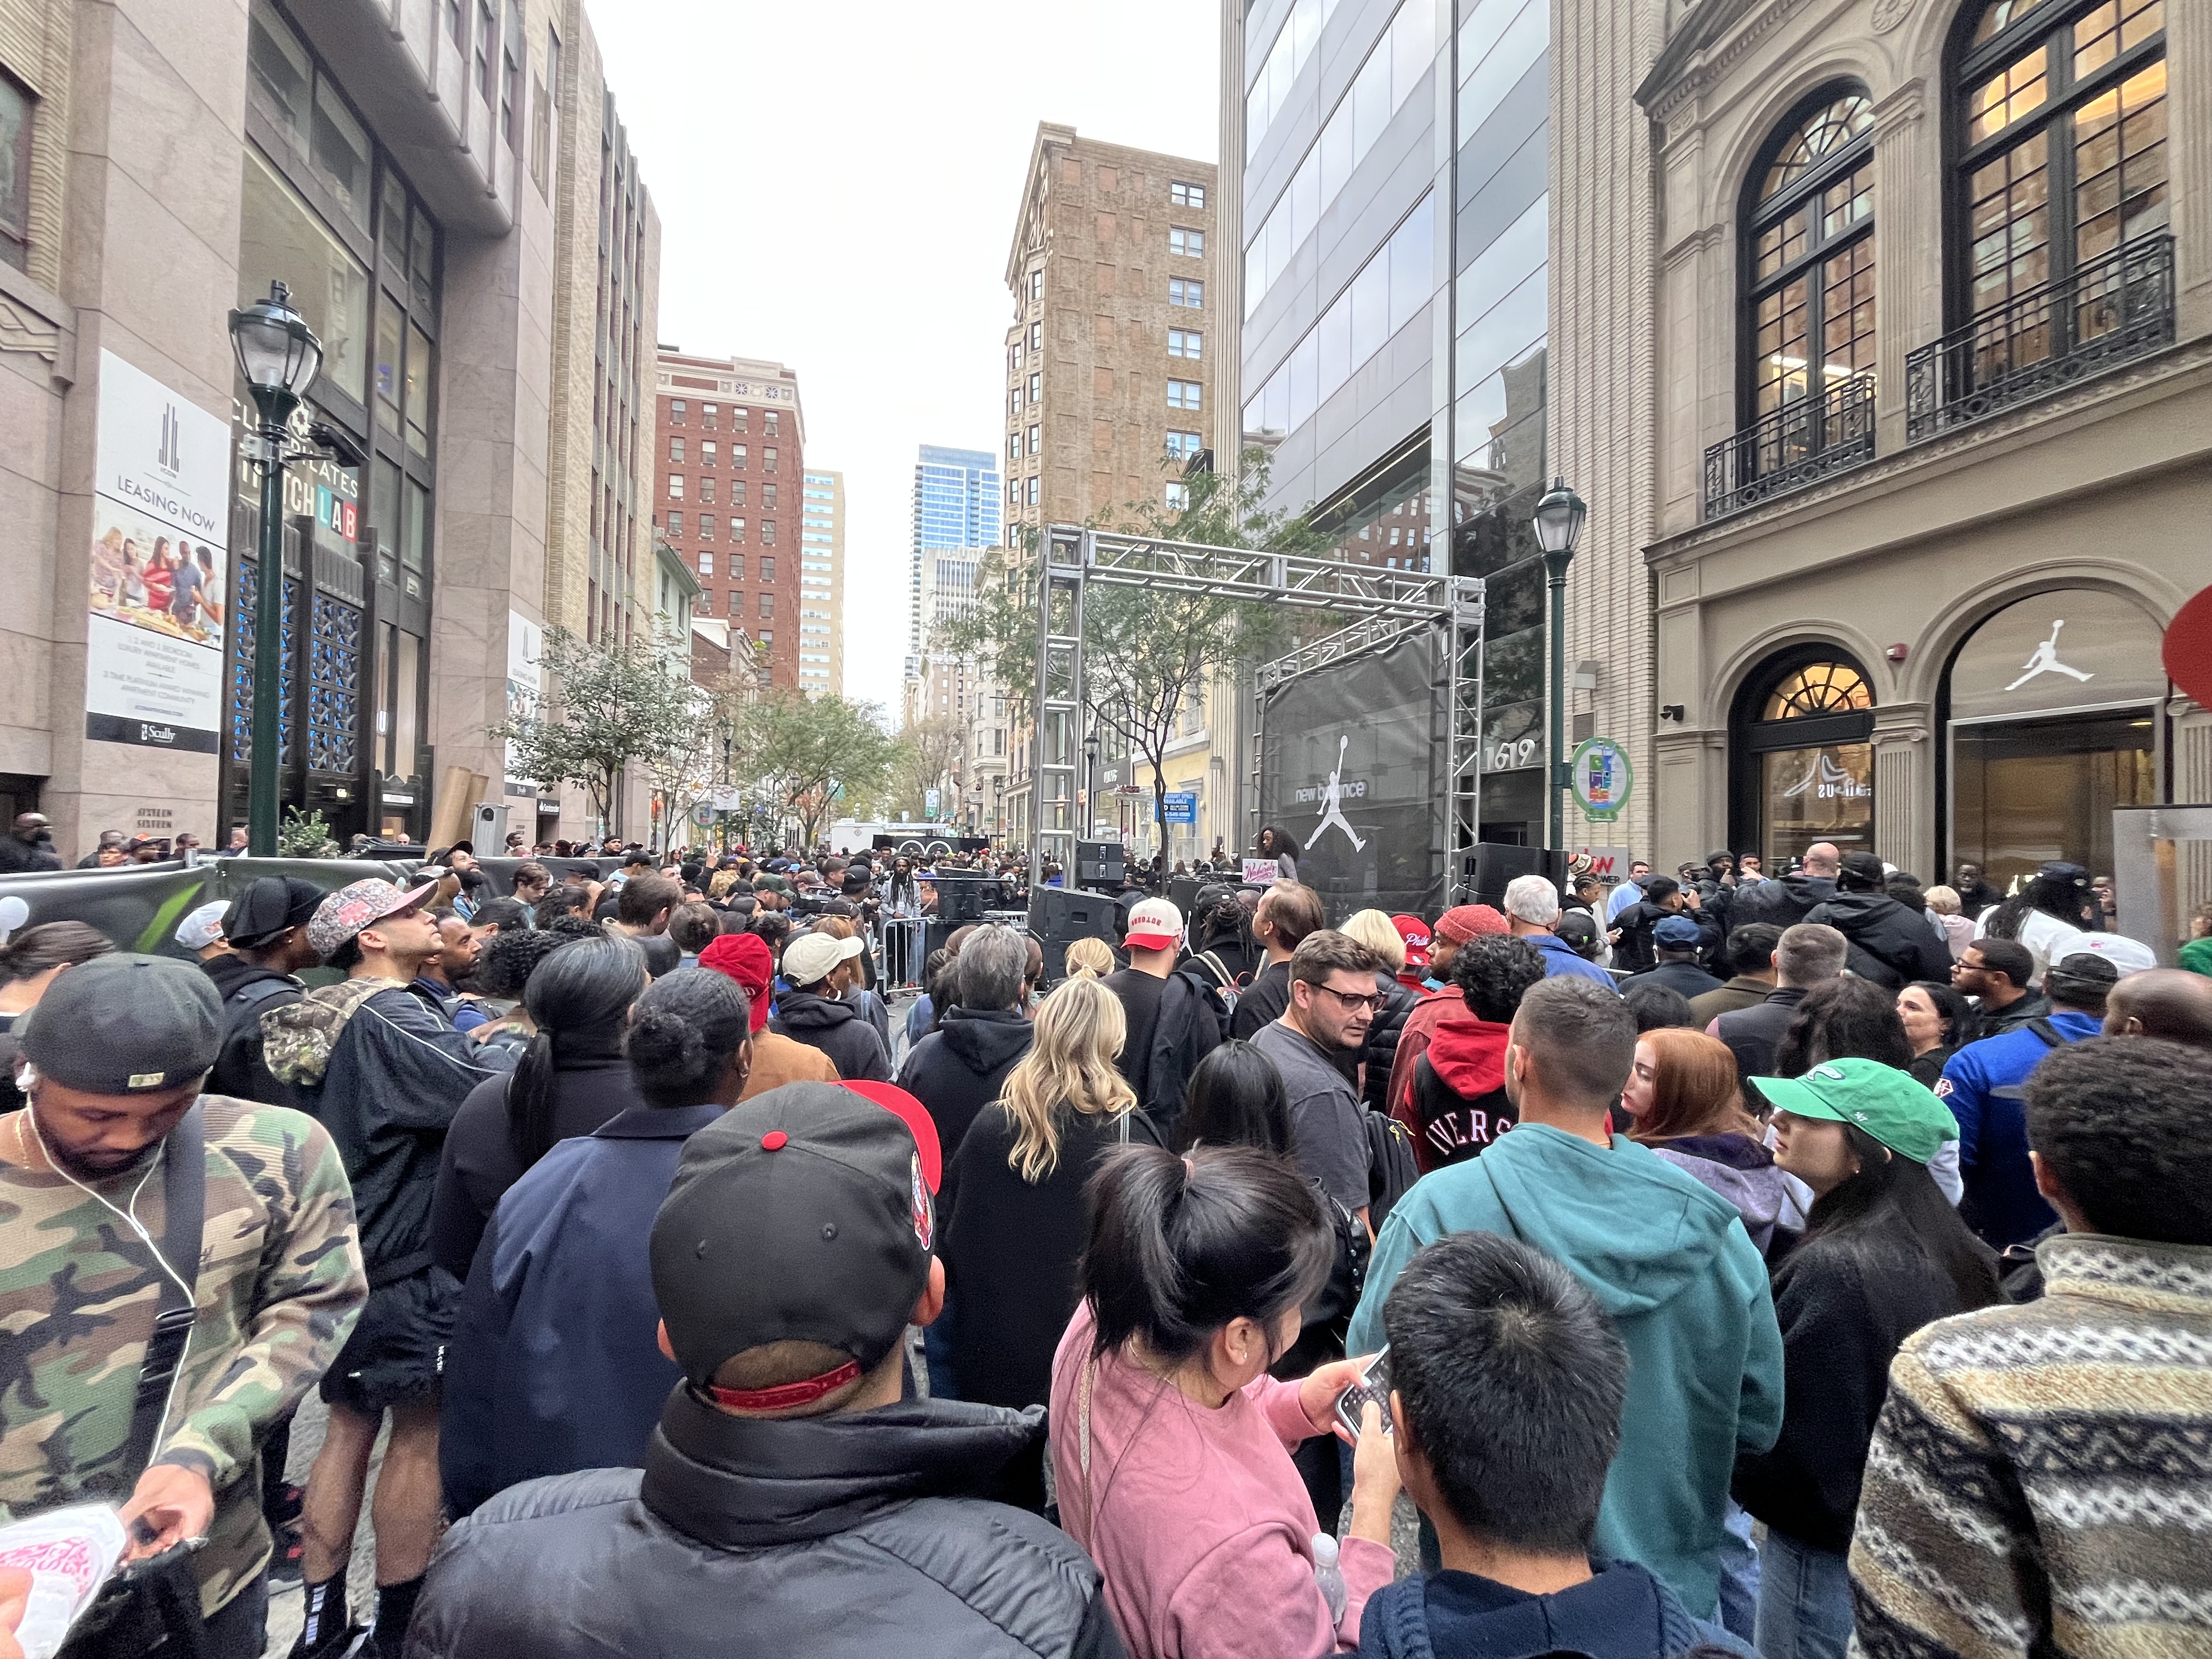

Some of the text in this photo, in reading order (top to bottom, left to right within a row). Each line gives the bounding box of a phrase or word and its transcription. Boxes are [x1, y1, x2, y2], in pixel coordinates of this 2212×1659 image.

[118, 475, 215, 532] LEASING NOW
[148, 725, 177, 741] Scully
[1484, 738, 1536, 771] 1619
[1296, 788, 1317, 803] new
[137, 808, 173, 817] SIXTEEN
[136, 820, 172, 828] SIXTEEN
